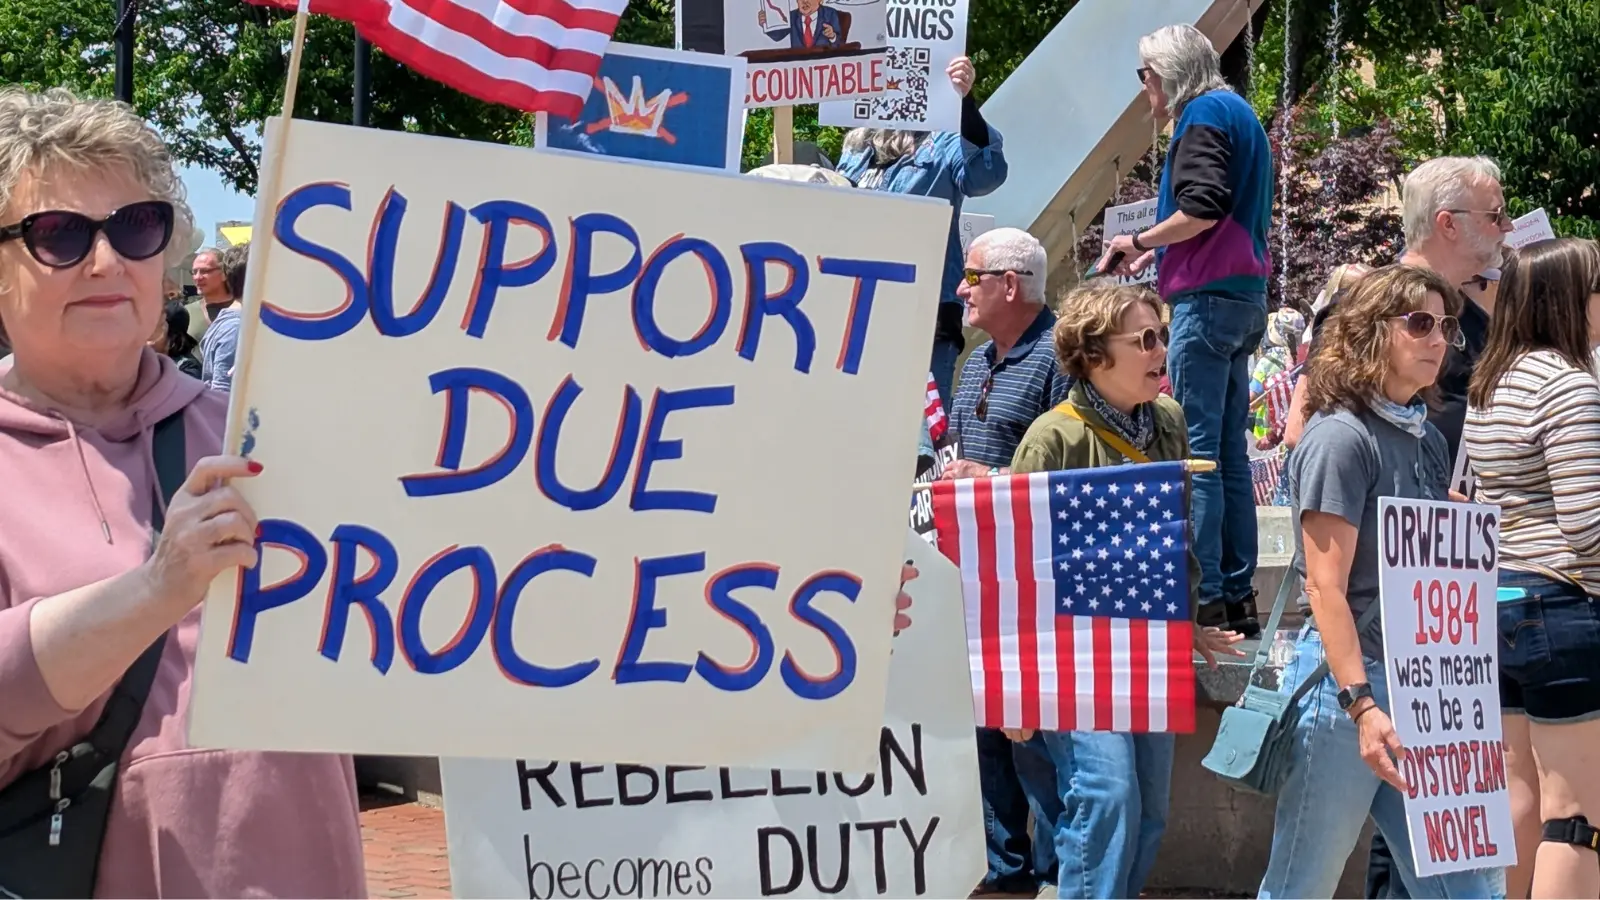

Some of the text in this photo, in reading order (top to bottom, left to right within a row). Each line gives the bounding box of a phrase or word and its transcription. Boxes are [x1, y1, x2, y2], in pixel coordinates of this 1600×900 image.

[1117, 210, 1135, 224] This
[1137, 207, 1147, 220] all
[260, 181, 917, 376] SUPPORT
[401, 369, 736, 513] DUE
[1384, 504, 1497, 573] ORWELL'S
[228, 519, 863, 702] PROCESS
[1413, 579, 1479, 645] 1984
[1394, 653, 1493, 687] was meant
[1411, 688, 1484, 733] to be a
[1403, 740, 1506, 799] DYSTOPIAN
[523, 816, 941, 899] becomes DUTY
[1423, 804, 1498, 863] NOVEL
